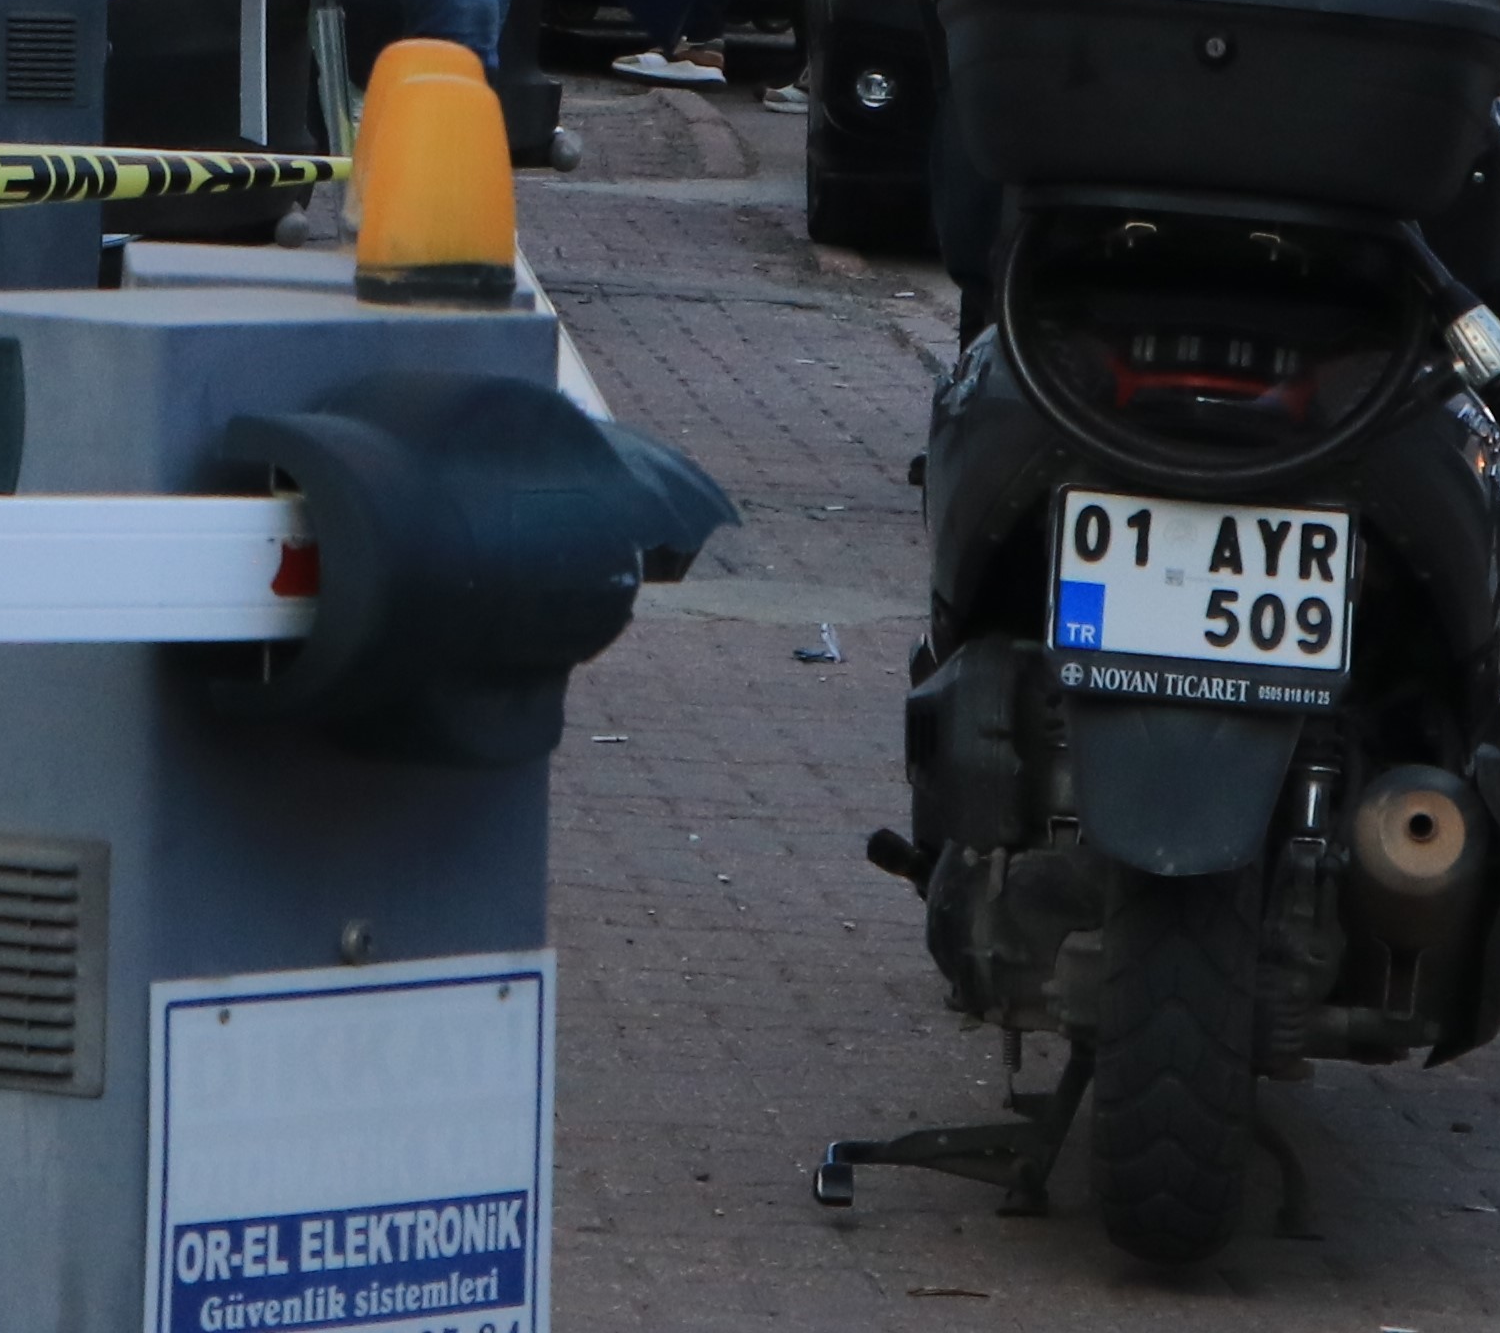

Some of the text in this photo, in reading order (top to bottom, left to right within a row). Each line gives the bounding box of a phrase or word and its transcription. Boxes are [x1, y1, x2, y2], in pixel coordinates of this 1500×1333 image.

[1073, 504, 1339, 583] 01 AYR
[1066, 621, 1096, 644] TR
[1203, 588, 1333, 655] 509
[1089, 665, 1158, 694] NOYAN
[175, 1224, 290, 1285] OR-EL
[200, 1268, 500, 1332] Güvenlik sistemleri
